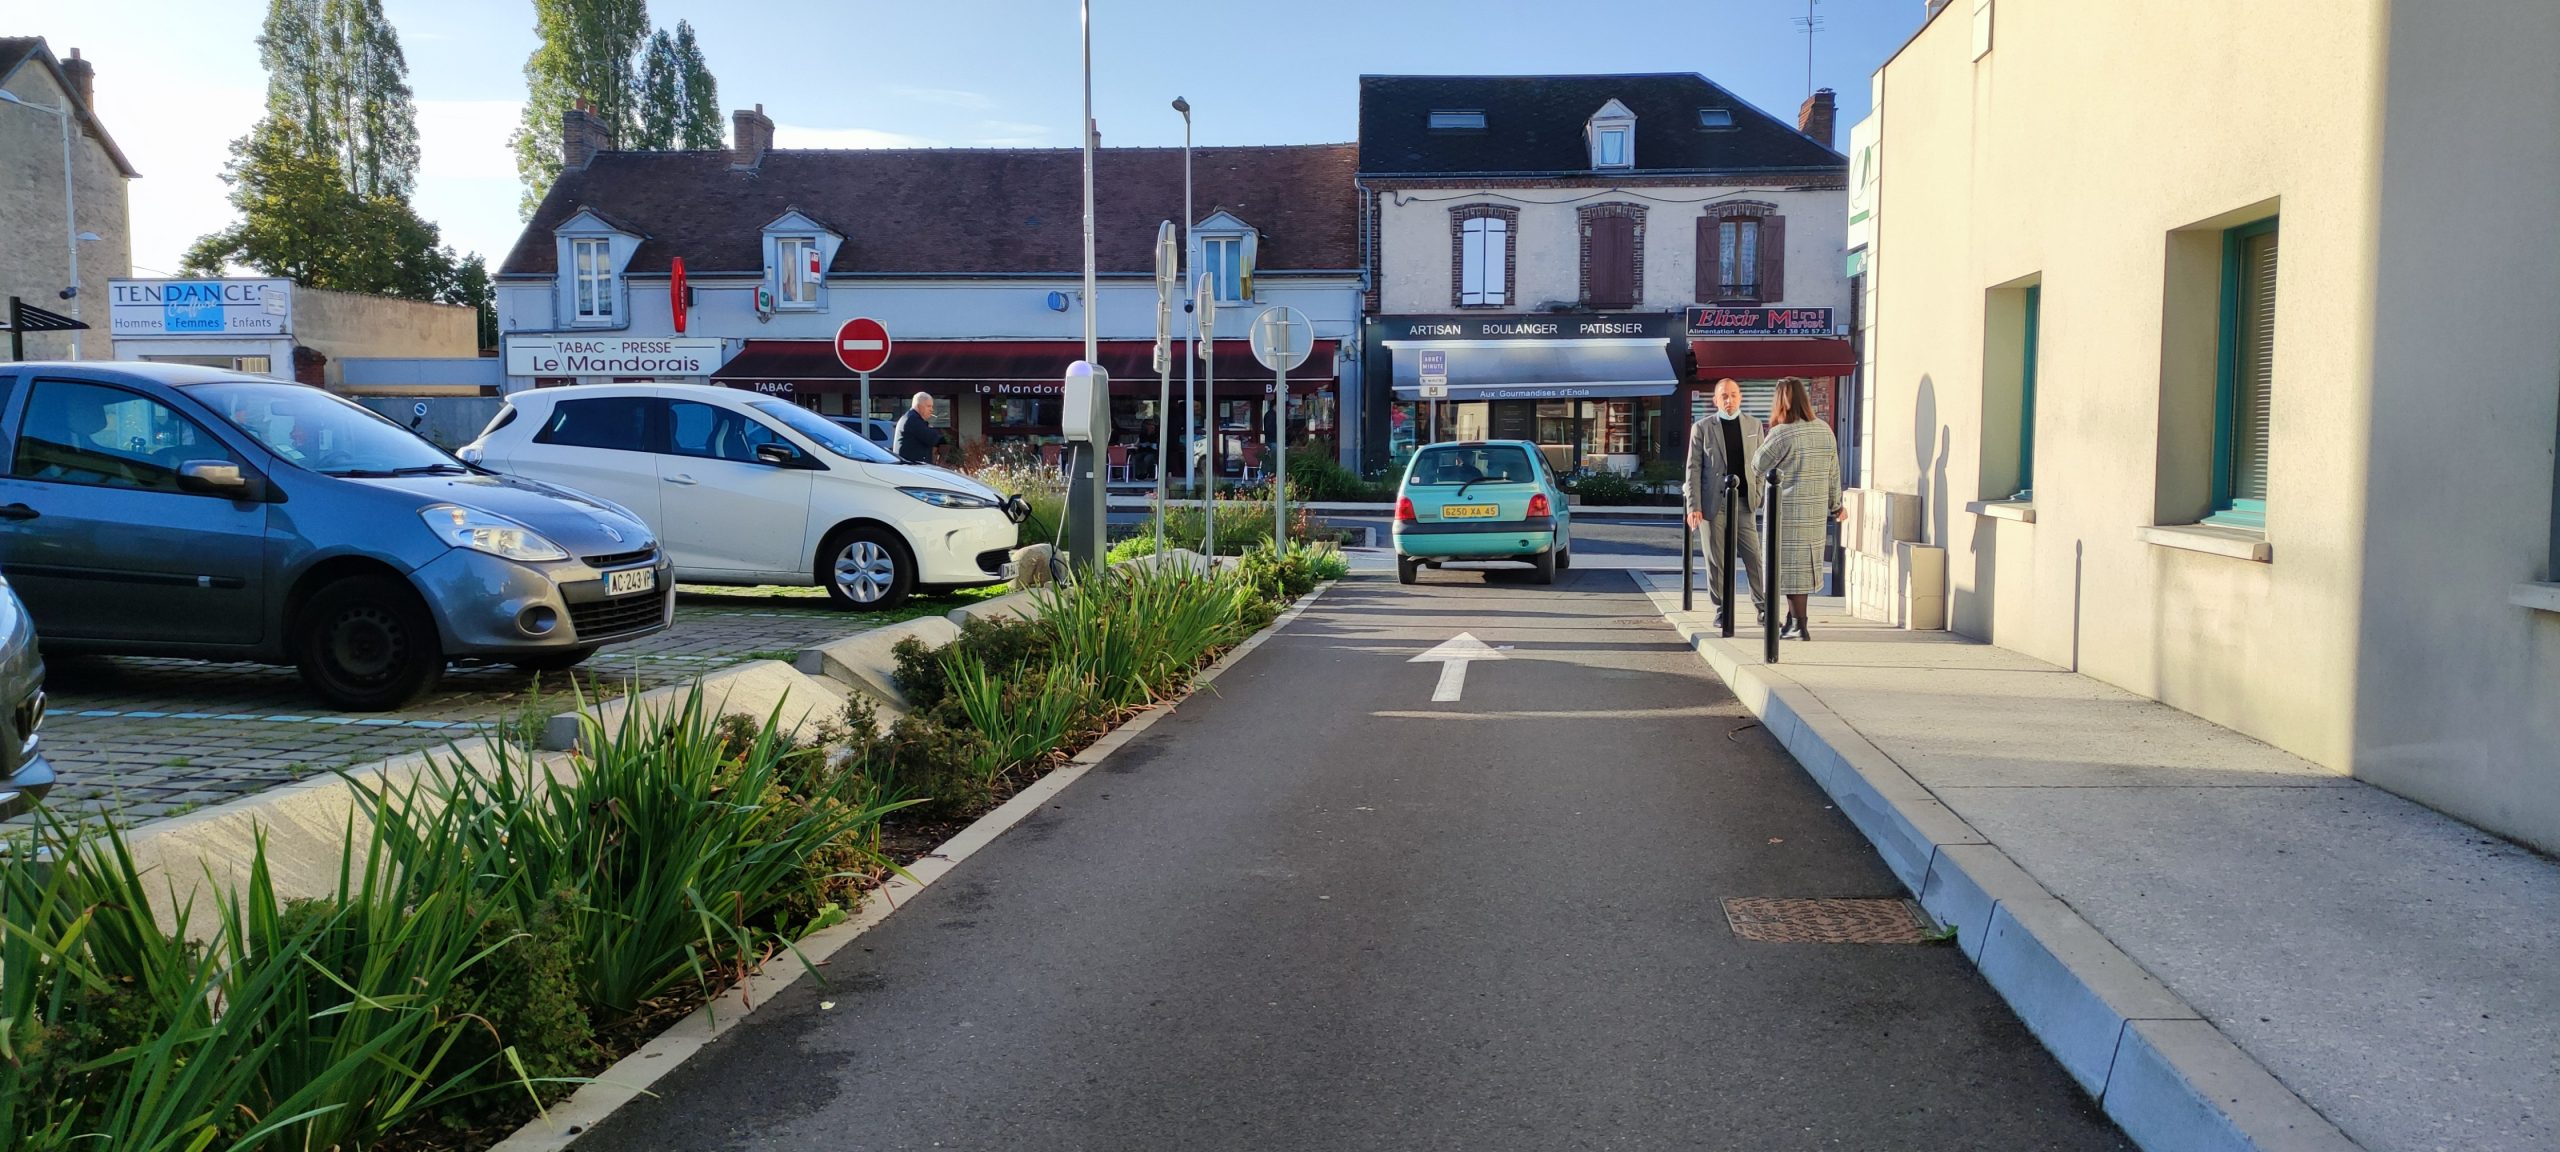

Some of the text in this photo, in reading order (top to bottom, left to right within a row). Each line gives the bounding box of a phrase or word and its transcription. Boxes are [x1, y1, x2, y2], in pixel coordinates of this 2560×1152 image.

[115, 316, 272, 329] Hommes Femmes Enfants
[1696, 309, 1825, 329] Elixir Mini
[1409, 323, 1643, 336] ARTISAN BOULANGER PATISSIER
[557, 341, 605, 354] TABAC
[622, 341, 671, 354] PRESSE
[533, 355, 700, 372] Le Mandorais
[754, 382, 794, 392] TABAC
[975, 383, 991, 393] Le
[1480, 388, 1590, 398] Aux Gourmandises d'Enola
[1445, 507, 1467, 516] 6250
[1470, 507, 1482, 516] XA
[1484, 506, 1496, 515] 45
